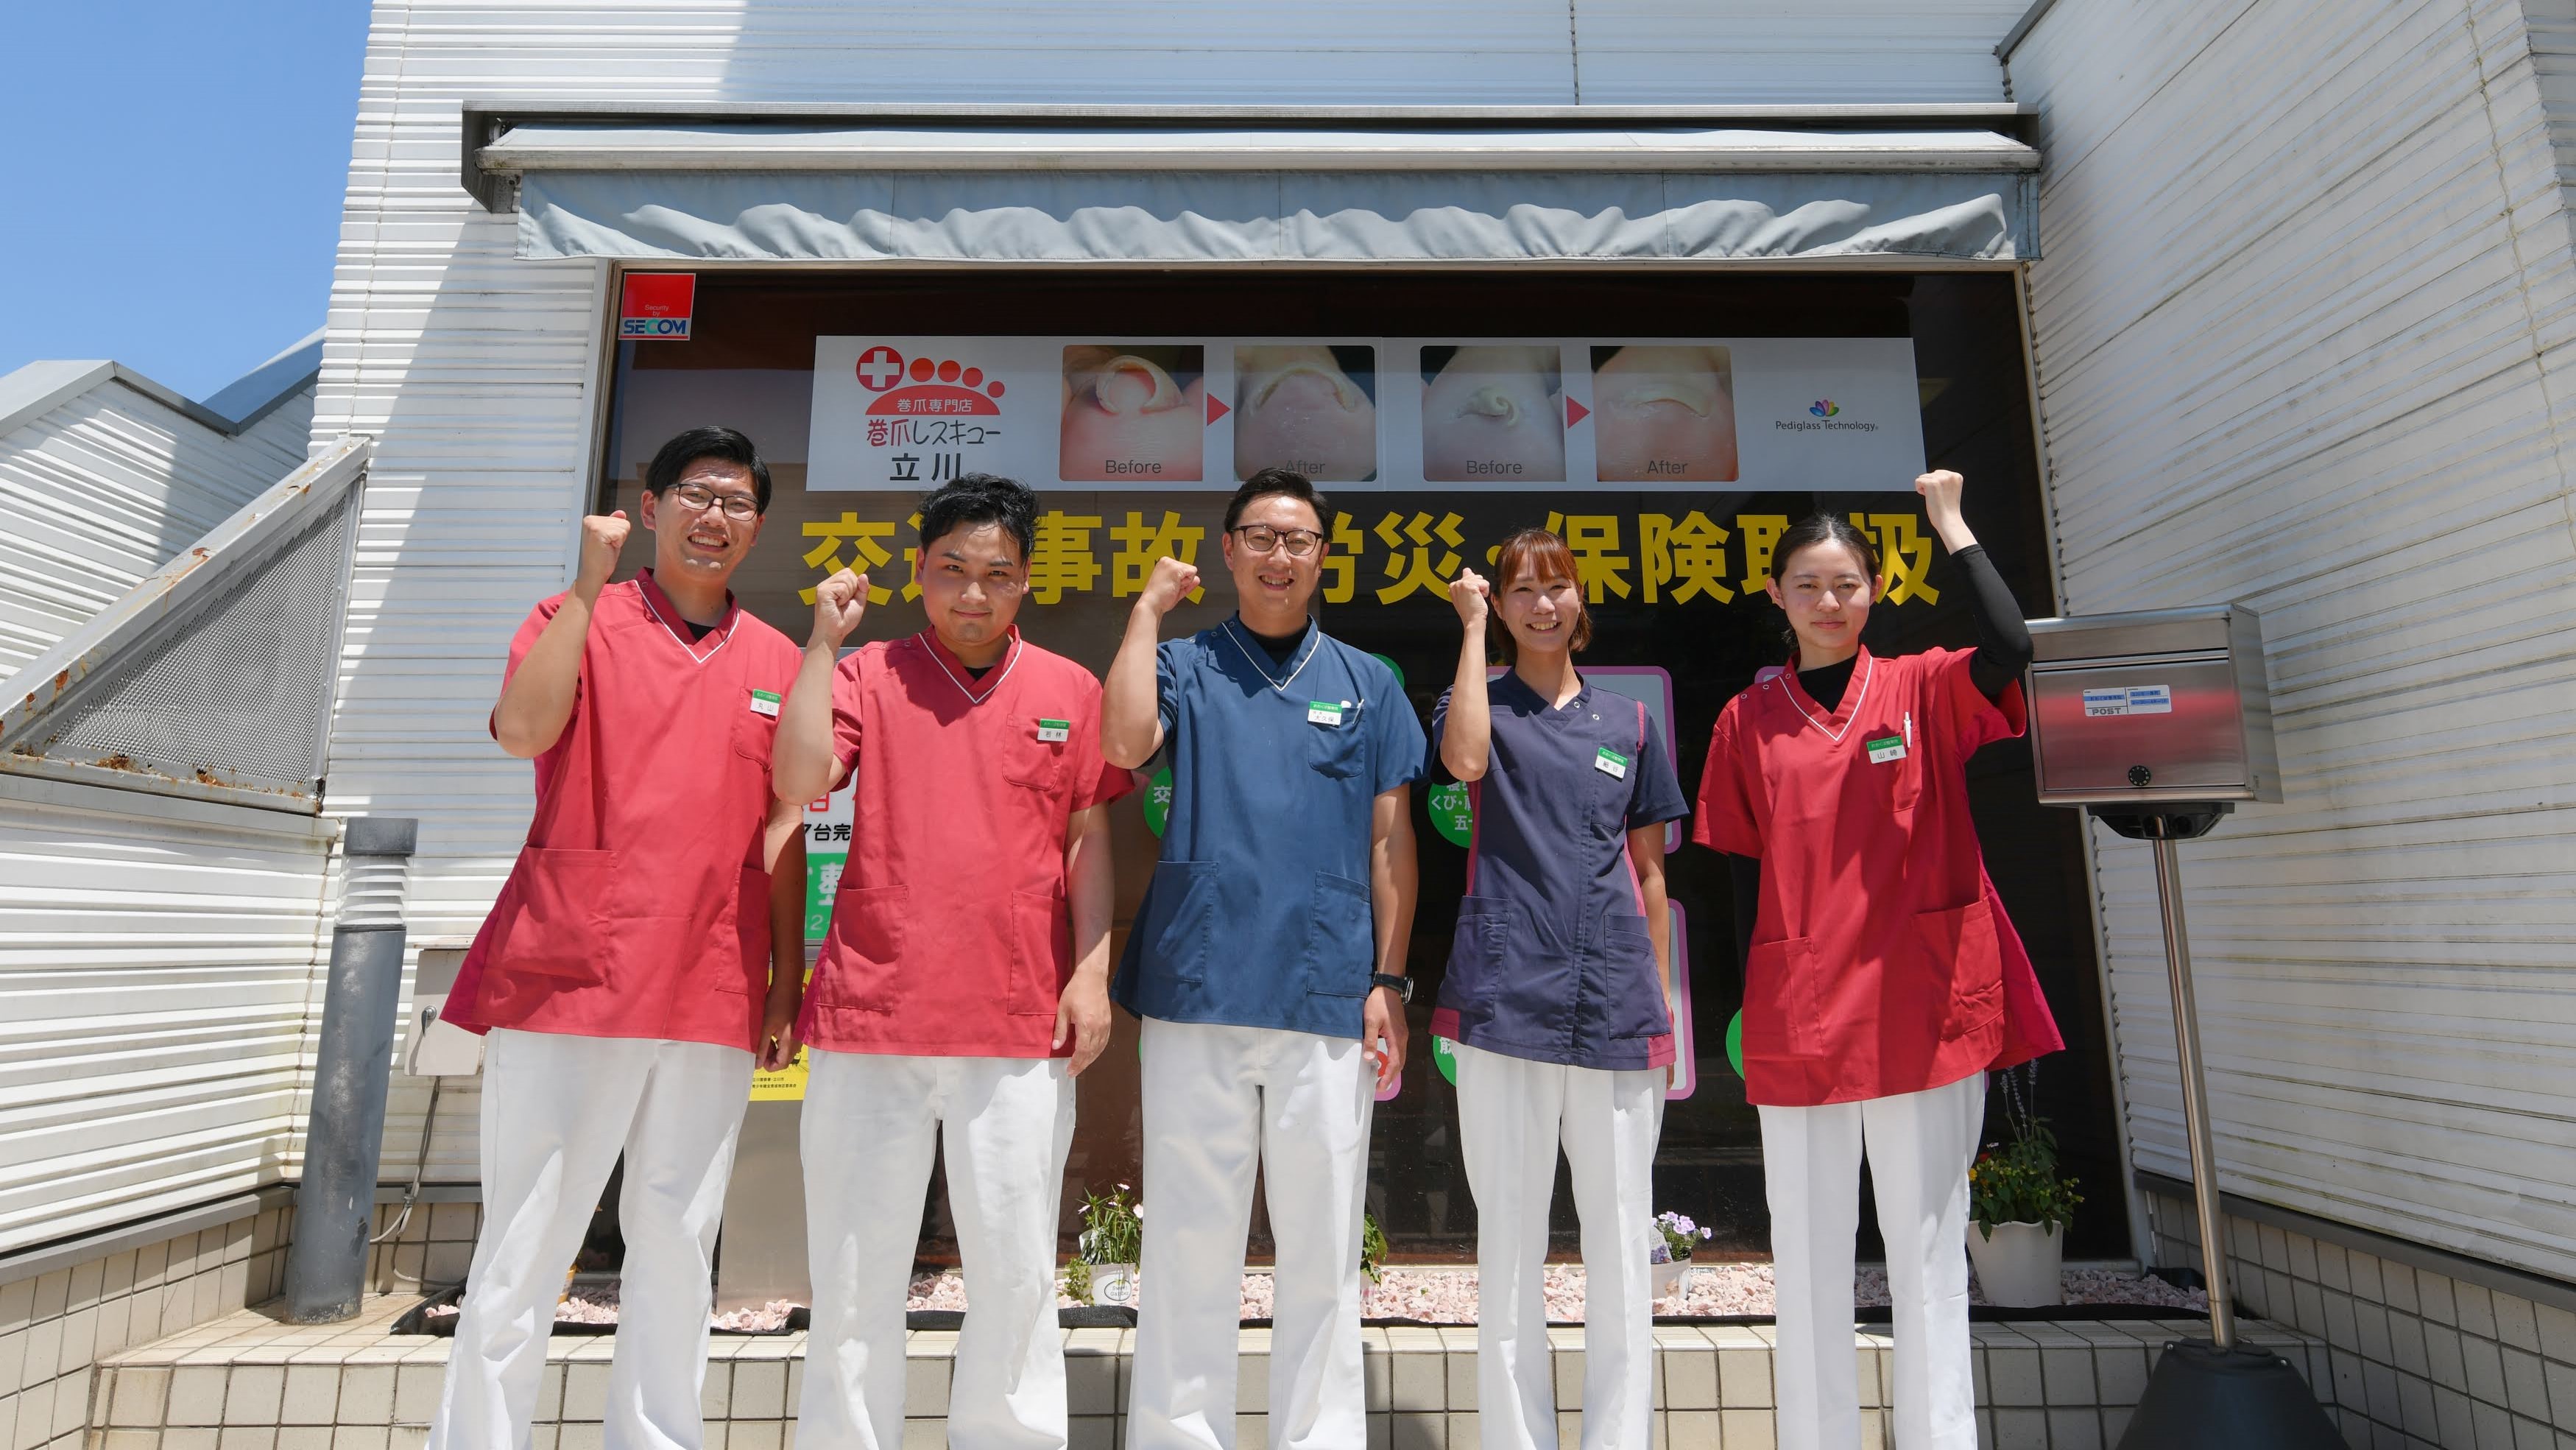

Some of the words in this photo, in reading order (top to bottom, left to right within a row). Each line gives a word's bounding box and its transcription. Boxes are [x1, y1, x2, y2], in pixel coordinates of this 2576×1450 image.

[624, 318, 686, 334] SECOM
[897, 398, 973, 412] 巻爪専門店
[867, 418, 1001, 447] 巻爪レスキュー
[1776, 420, 1821, 432] Pediglass
[889, 452, 961, 482] 立川
[1106, 460, 1161, 474] Before
[1285, 460, 1325, 474] After
[1467, 460, 1522, 474] Before
[1647, 460, 1688, 474] After
